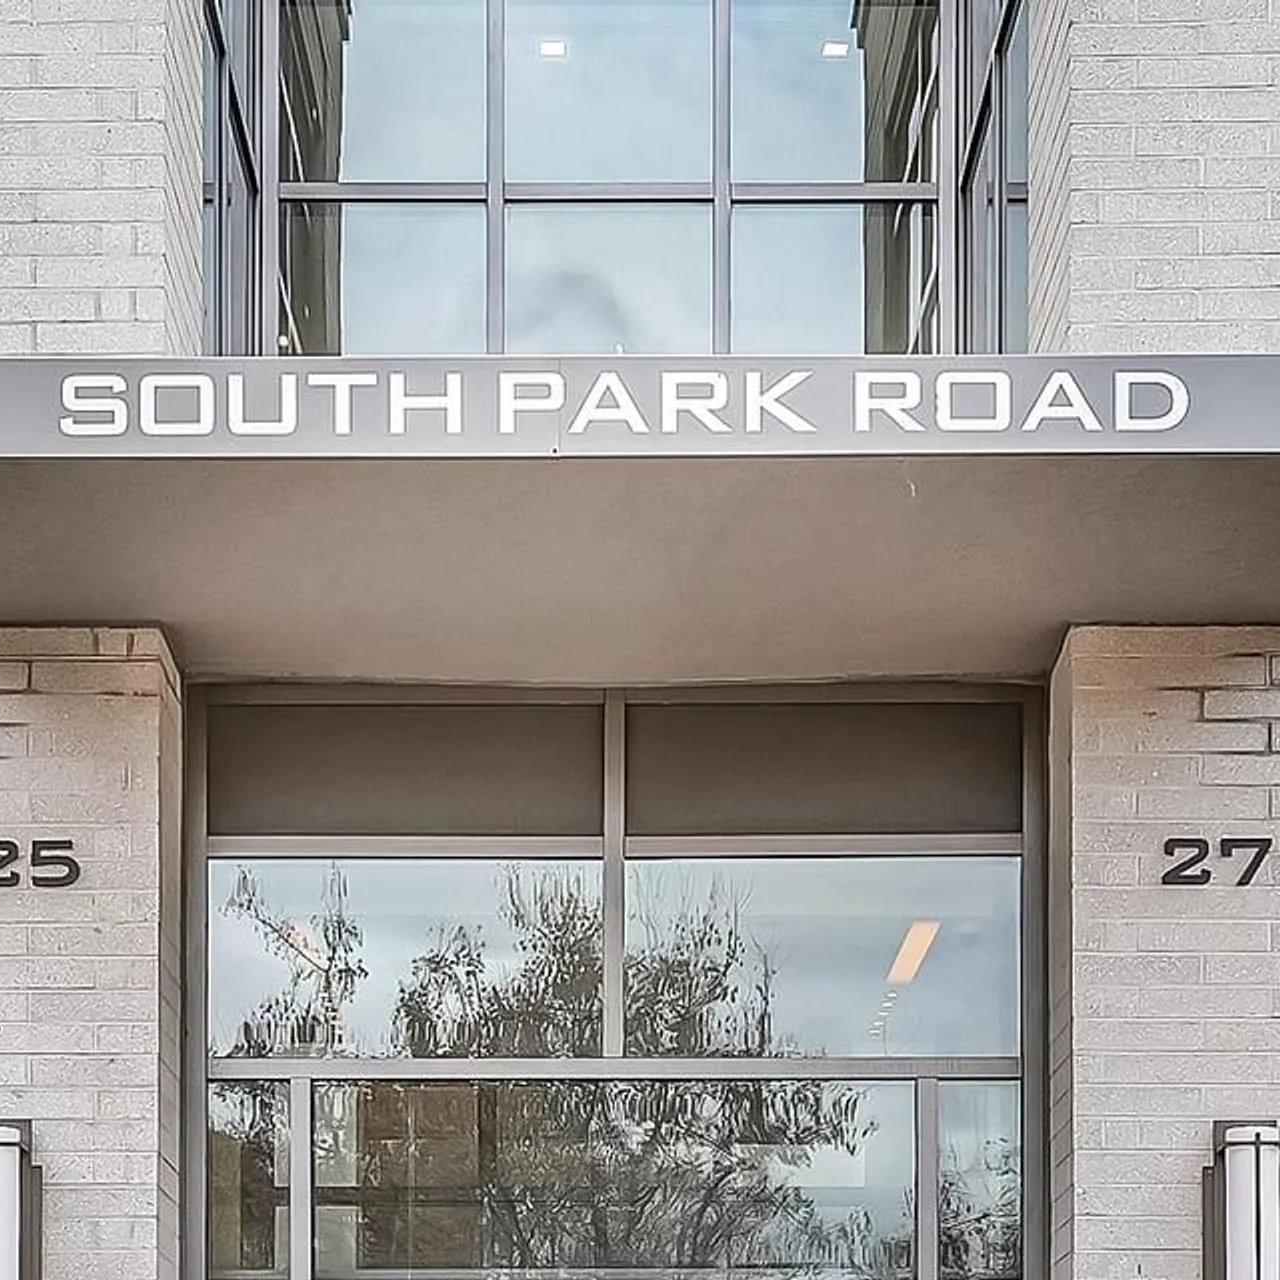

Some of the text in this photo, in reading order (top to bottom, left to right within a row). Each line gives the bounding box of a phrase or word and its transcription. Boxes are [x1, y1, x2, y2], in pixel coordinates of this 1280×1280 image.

[59, 370, 1191, 436] SOUTH PARK ROAD
